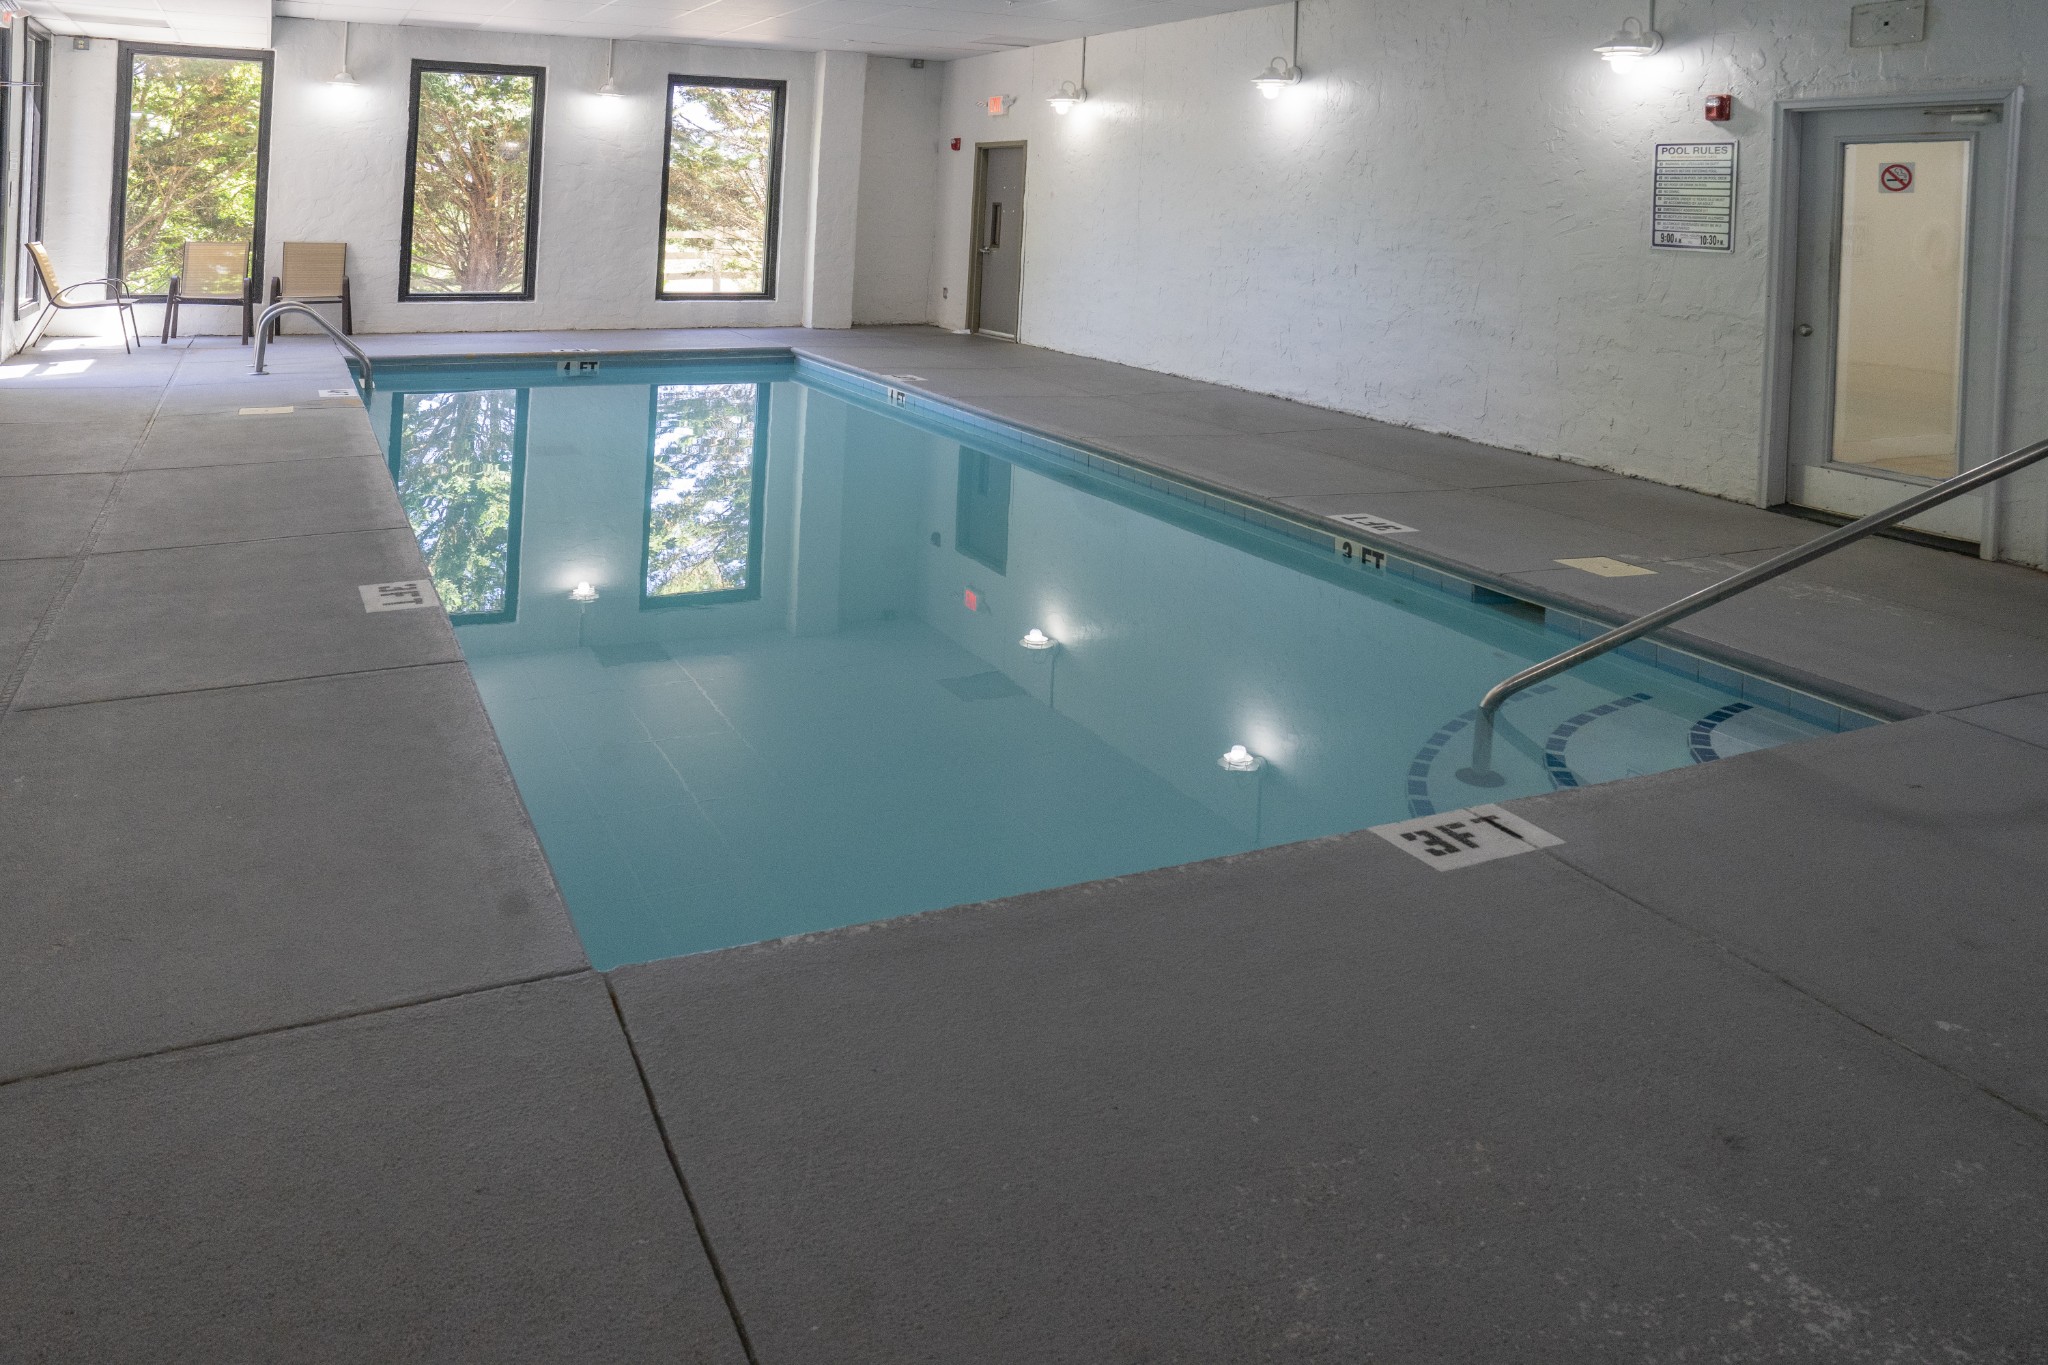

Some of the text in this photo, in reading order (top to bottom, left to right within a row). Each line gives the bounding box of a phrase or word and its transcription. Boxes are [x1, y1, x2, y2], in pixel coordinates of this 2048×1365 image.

[1661, 146, 1728, 155] POOL RULES
[1660, 233, 1674, 243] 9:00
[1700, 235, 1717, 245] 10:30
[579, 361, 598, 370] FT
[1361, 546, 1385, 569] FT
[1400, 815, 1523, 857] 3FT
